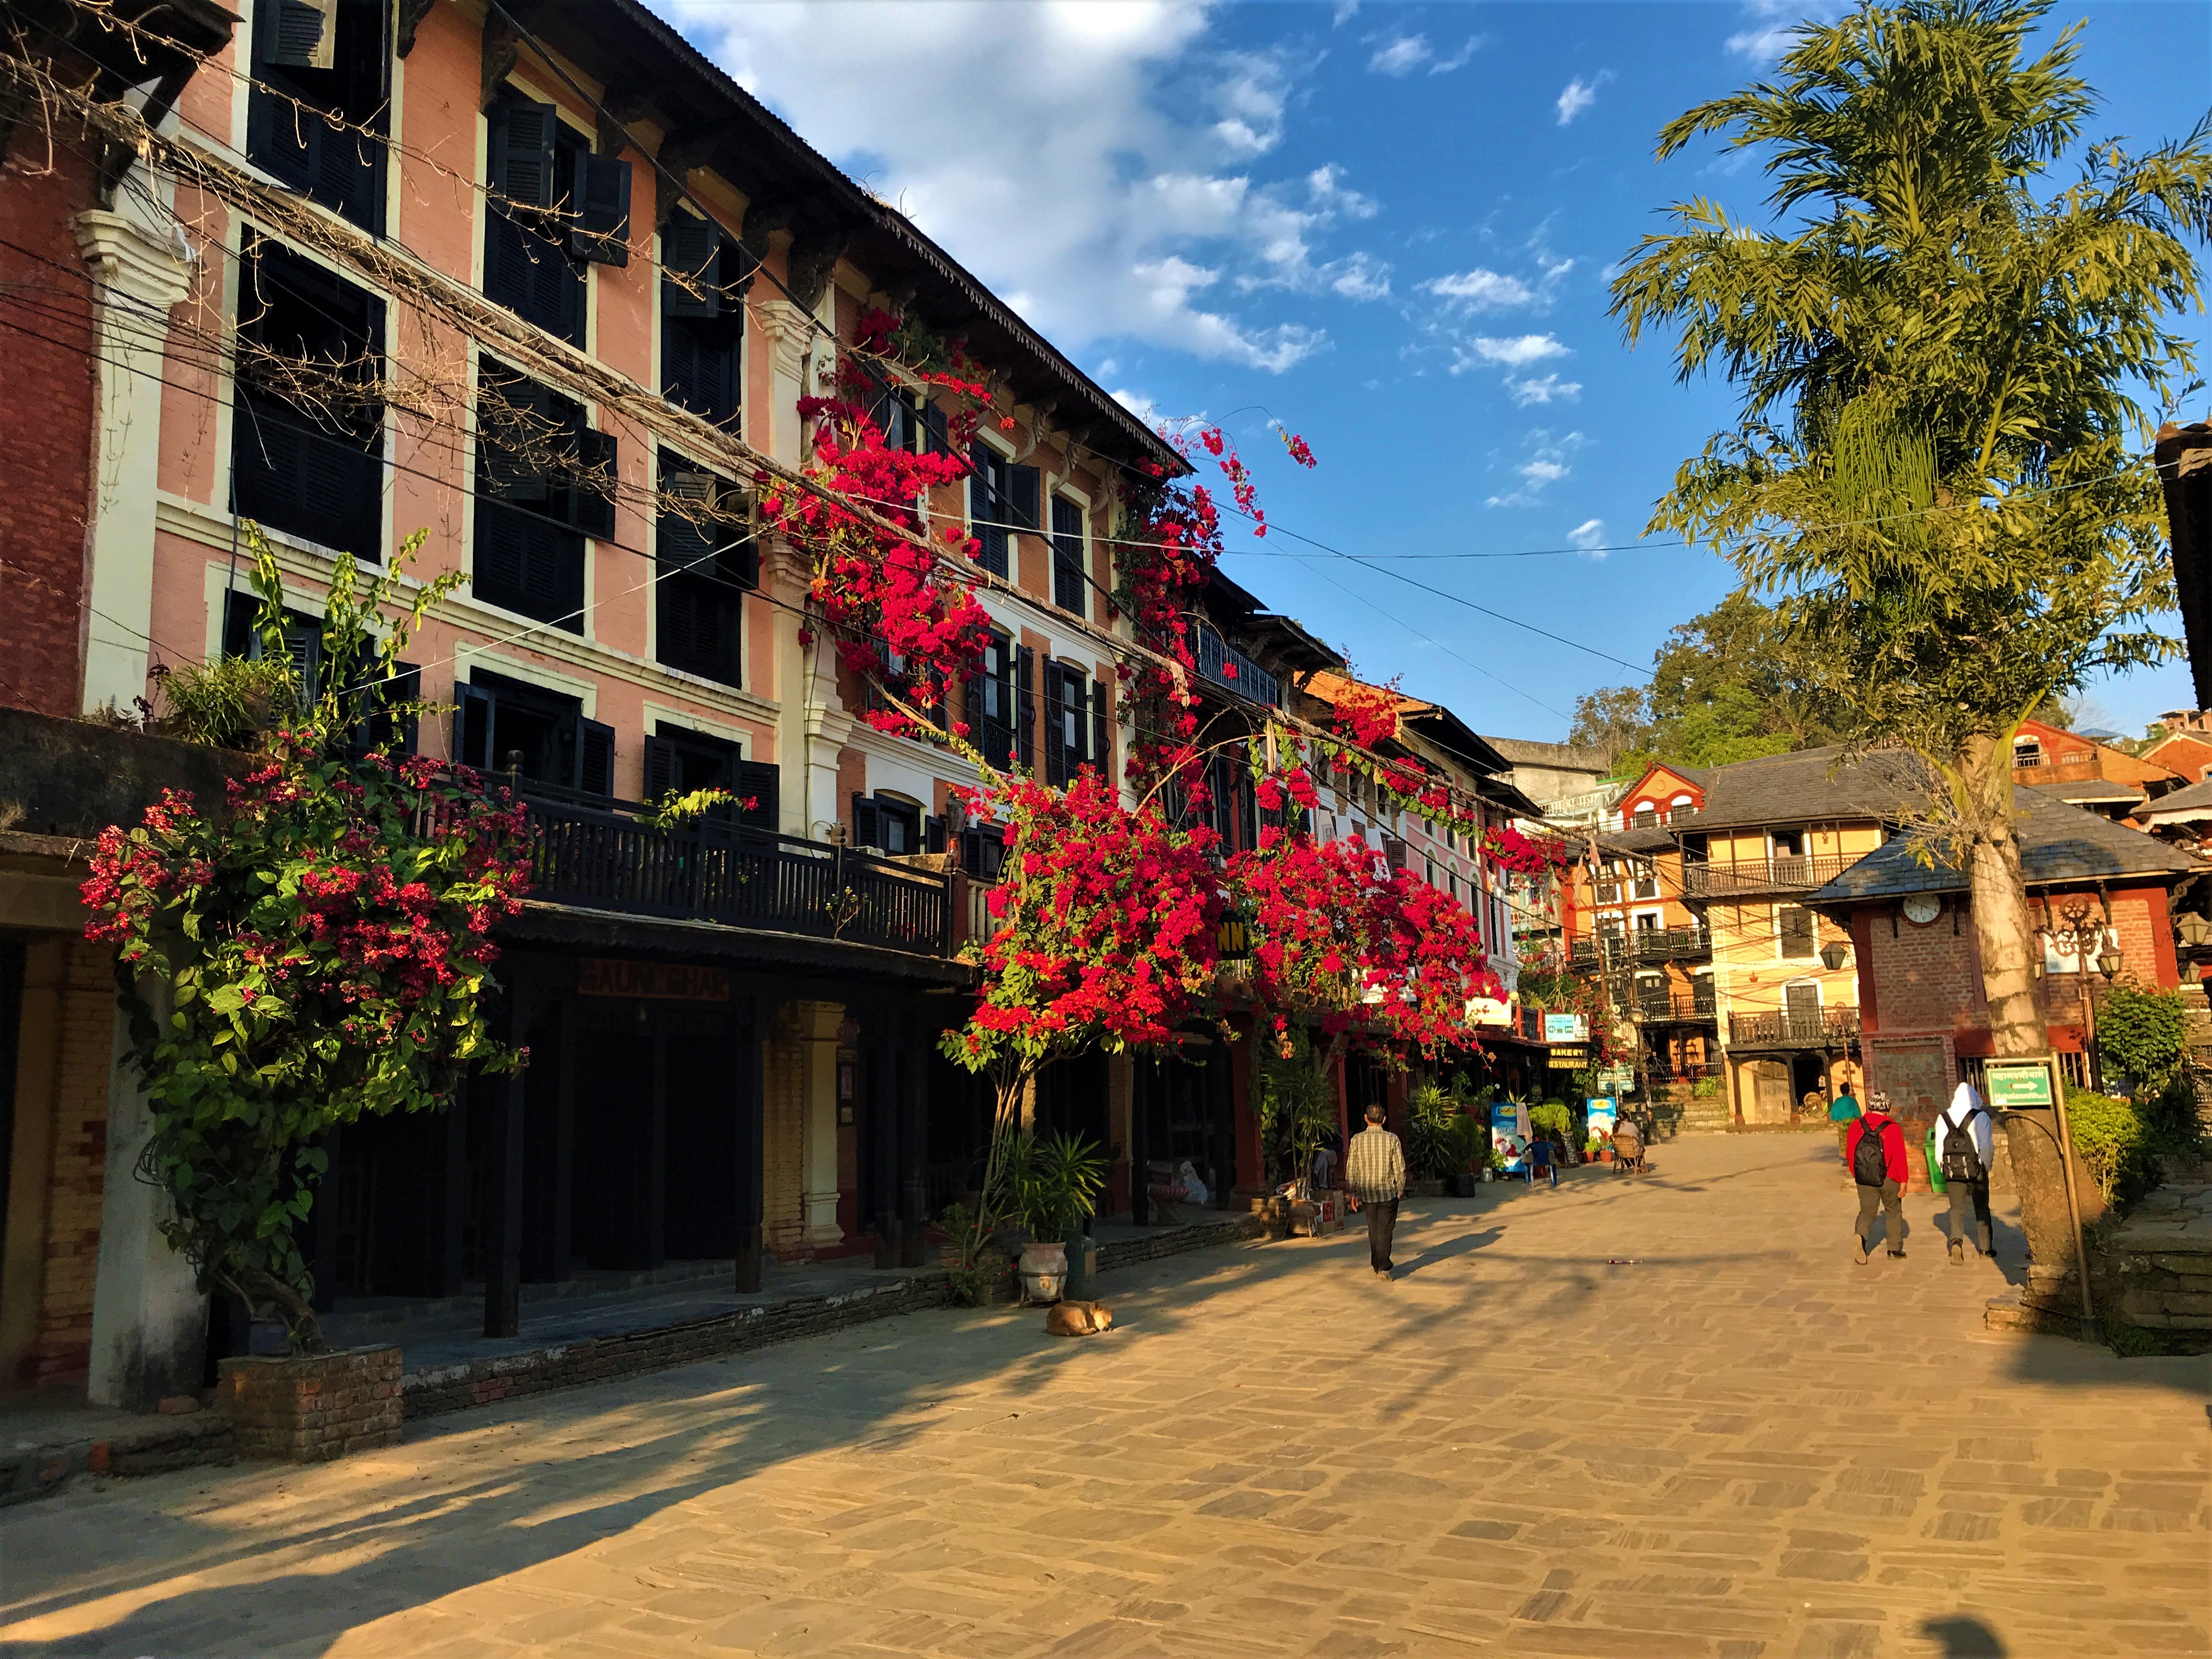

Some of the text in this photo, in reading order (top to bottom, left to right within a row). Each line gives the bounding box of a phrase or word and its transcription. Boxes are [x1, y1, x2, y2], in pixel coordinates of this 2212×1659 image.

[1211, 922, 1244, 952] NN
[580, 961, 730, 998] GAUN GHAR
